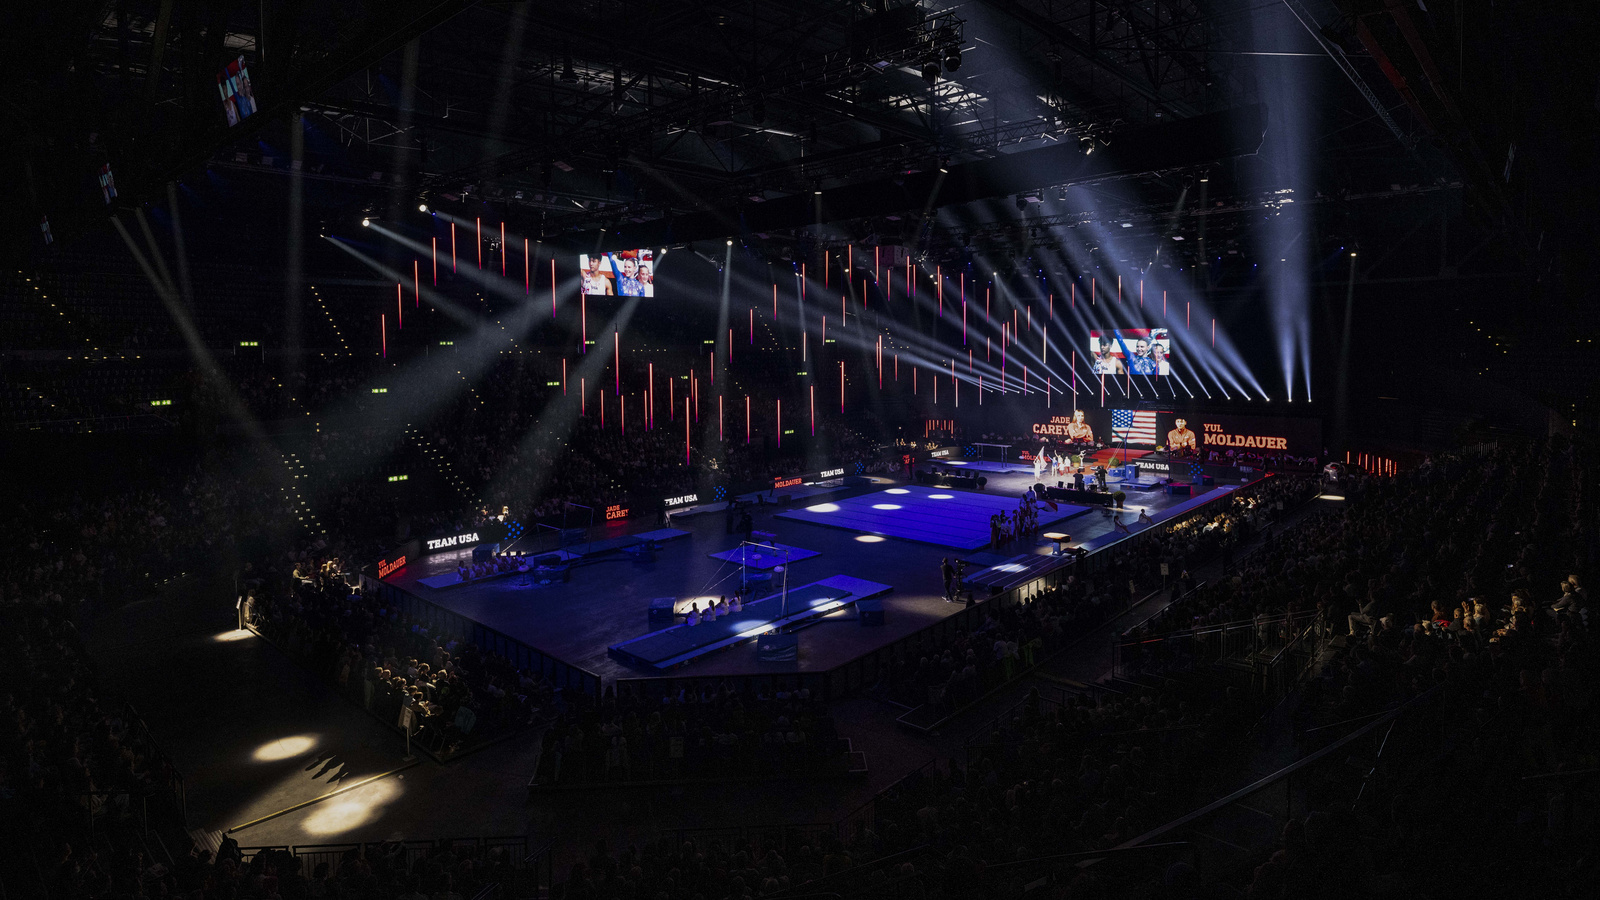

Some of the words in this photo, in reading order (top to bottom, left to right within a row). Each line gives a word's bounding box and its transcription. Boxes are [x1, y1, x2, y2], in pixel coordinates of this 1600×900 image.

[1033, 423, 1069, 435] CAREY
[1203, 423, 1223, 432] YUL
[1203, 433, 1287, 449] MOLDAUER
[820, 470, 834, 478] TEAM
[774, 478, 802, 488] MOLDAUER
[684, 494, 698, 502] USA
[427, 537, 457, 549] TEAM
[458, 532, 479, 543] USA
[378, 555, 406, 579] MOLDAUER
